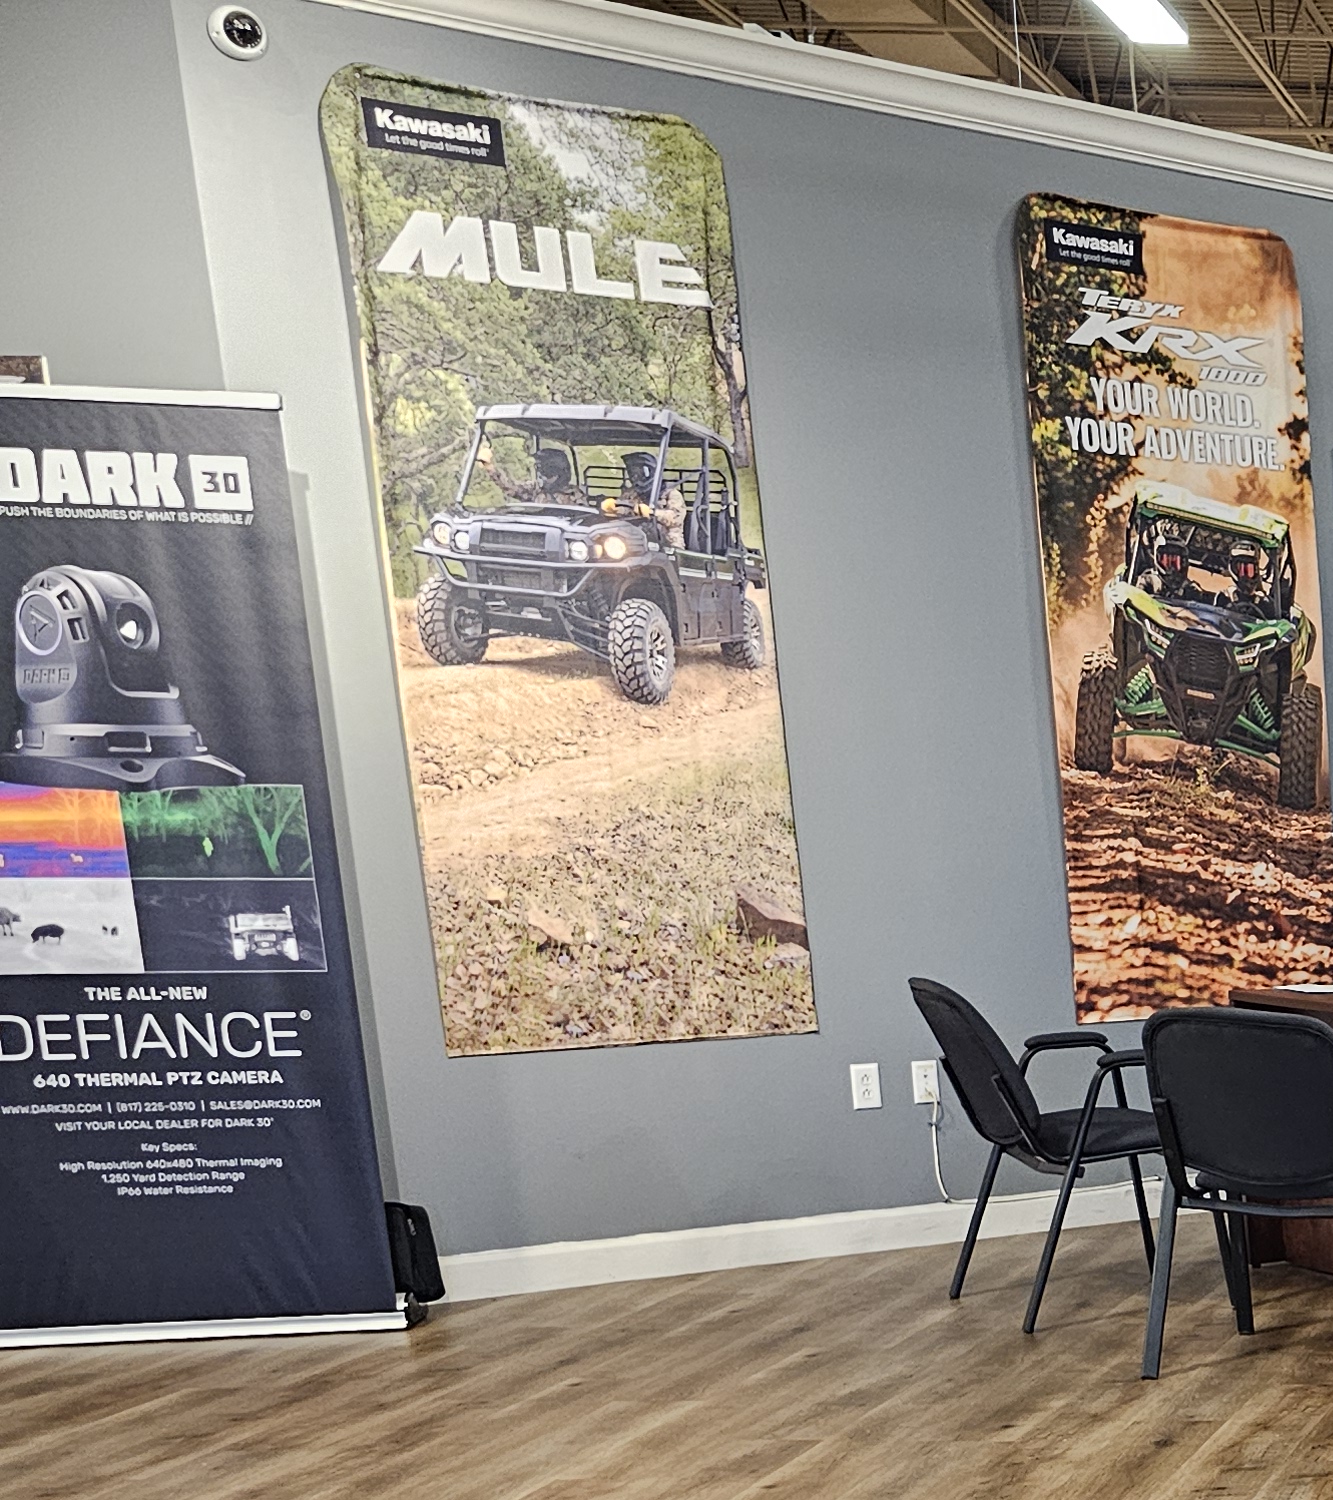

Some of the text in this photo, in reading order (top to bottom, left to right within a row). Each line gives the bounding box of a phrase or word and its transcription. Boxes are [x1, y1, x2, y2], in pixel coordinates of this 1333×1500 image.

[374, 106, 491, 145] Kawasaki
[384, 133, 401, 145] Let
[401, 135, 418, 147] the
[419, 139, 444, 151] good
[445, 142, 470, 155] times
[1052, 227, 1134, 256] Kawasaki
[376, 209, 714, 309] MULE
[1059, 248, 1070, 257] Let
[1071, 250, 1082, 259] the
[1082, 252, 1101, 263] good
[1101, 255, 1119, 265] times
[1078, 287, 1185, 319] TERYX
[1065, 309, 1268, 369] KRX
[1199, 366, 1268, 387] 1000
[1090, 376, 1261, 429] YOUR WORLD.
[1065, 416, 1286, 471] YOUR ADVENTURE.
[0, 447, 185, 508] DARK
[30, 507, 54, 518] THE
[56, 508, 127, 520] BOUNDARIES
[128, 511, 144, 521] OF
[145, 511, 176, 523] WHAT
[177, 512, 189, 523] IS
[190, 512, 243, 524] POSSIBLE
[84, 985, 207, 1001] THE ALL-NEW
[33, 1070, 284, 1088] 640 THERMAL PTZ CAMERA
[116, 1102, 142, 1113] (817)
[55, 1122, 82, 1131] VISIT
[85, 1121, 116, 1131] YOUR
[118, 1120, 153, 1130] LOCAL
[156, 1119, 199, 1129] DEALER
[201, 1119, 223, 1128] FOR
[225, 1118, 255, 1127] DARK
[141, 1142, 197, 1153] Key Specs:
[59, 1161, 85, 1173] High
[87, 1160, 143, 1171] Resolution
[195, 1157, 238, 1168] Thermal
[240, 1156, 283, 1168] Imaging
[132, 1173, 157, 1183] Yard
[158, 1171, 210, 1182] Detection
[212, 1171, 245, 1182] Range
[117, 1184, 233, 1196] IP66 Water Resistance
